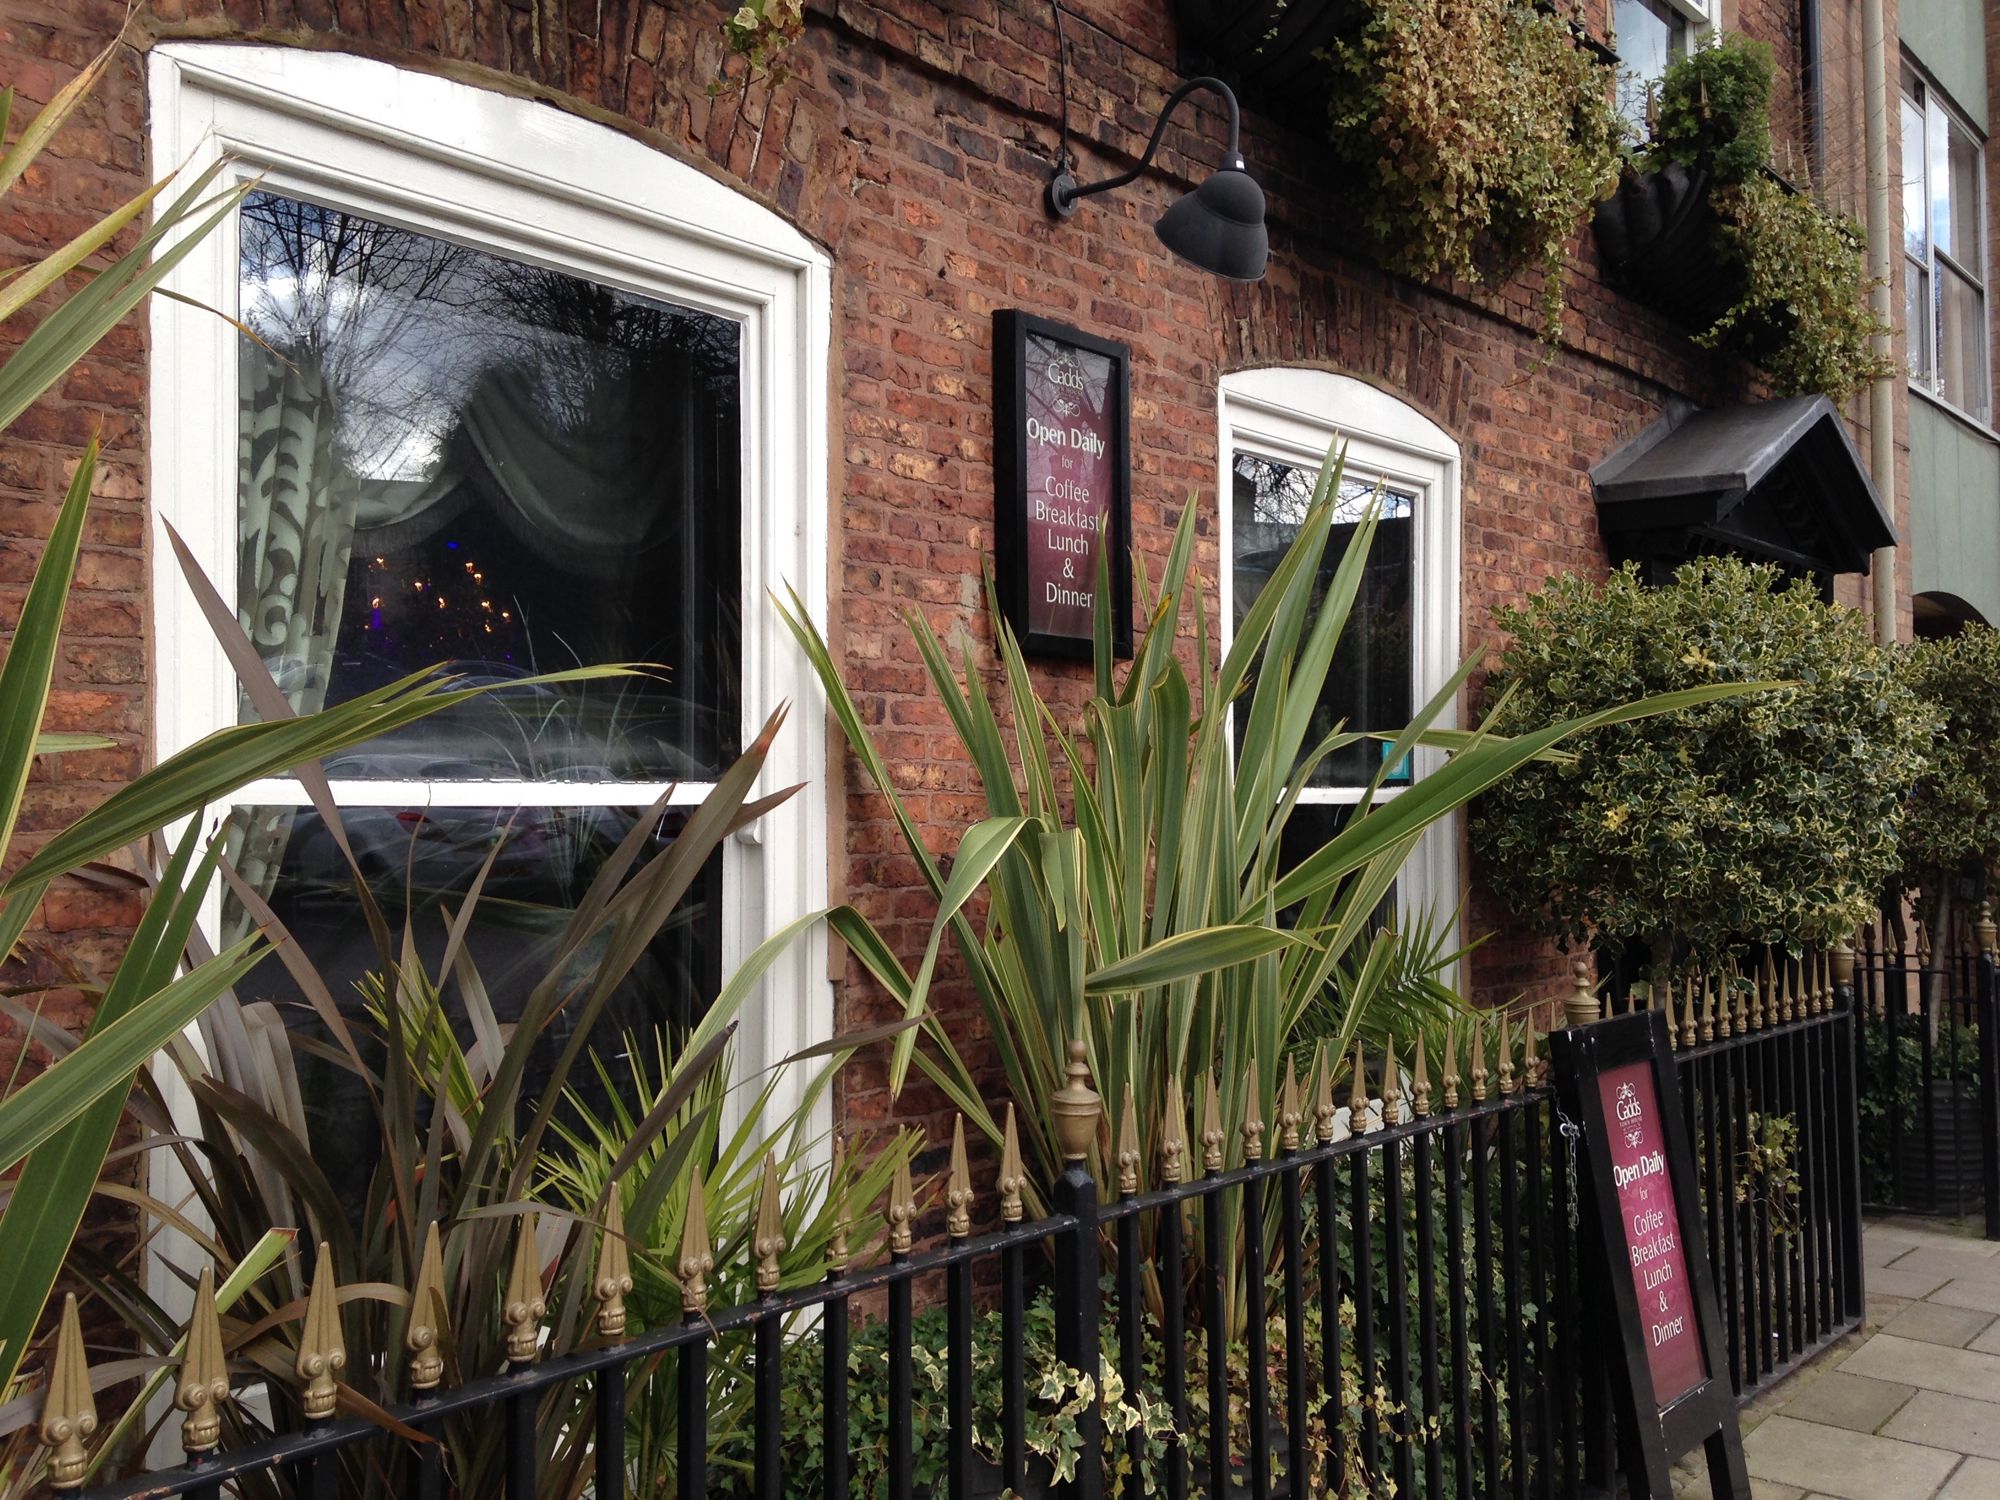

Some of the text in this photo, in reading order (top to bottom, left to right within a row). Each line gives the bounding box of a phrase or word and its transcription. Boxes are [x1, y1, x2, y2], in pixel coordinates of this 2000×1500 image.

[1048, 363, 1084, 391] Gadds
[1026, 417, 1105, 460] Open Daily
[1061, 455, 1073, 469] for
[1045, 475, 1090, 504] Coffee
[1035, 499, 1100, 532] Breakfast
[1048, 528, 1089, 556] Lunch
[1062, 557, 1075, 579] &
[1046, 581, 1093, 608] Dinner
[1616, 1097, 1642, 1121] Gadds
[1613, 1150, 1664, 1190] Open Daily
[1640, 1186, 1648, 1201] for
[1633, 1208, 1664, 1237] Coffee
[1631, 1231, 1676, 1267] Breakfast
[1643, 1259, 1673, 1291] Lunch
[1659, 1290, 1669, 1313] &
[1652, 1315, 1684, 1347] Dinner
